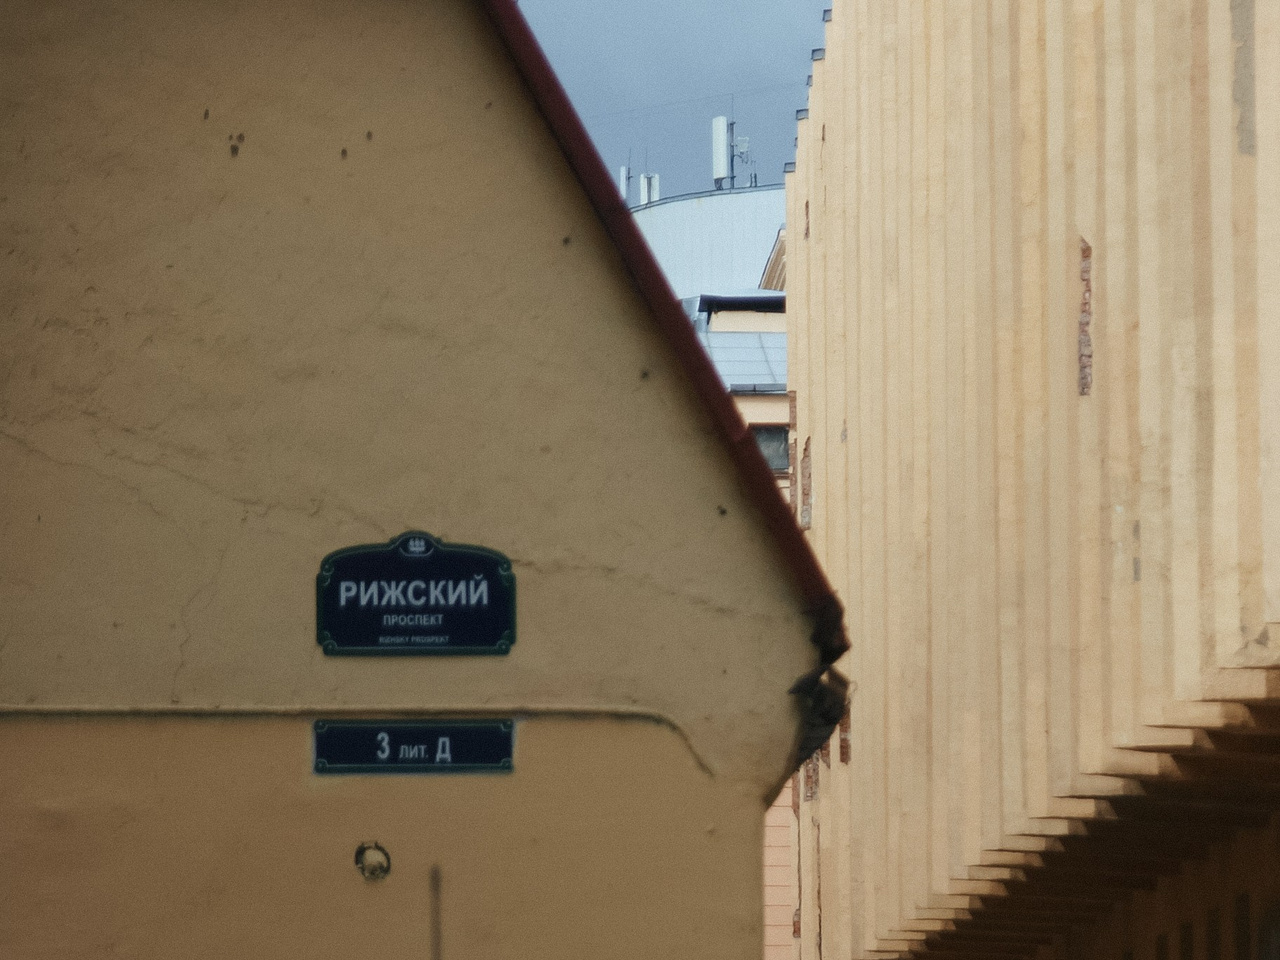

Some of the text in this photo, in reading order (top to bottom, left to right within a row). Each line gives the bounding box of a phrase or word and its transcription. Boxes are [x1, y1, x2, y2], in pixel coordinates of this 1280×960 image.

[339, 573, 489, 607] РИЖСКИЙ
[383, 614, 444, 626] ПРОСПЕКТ
[376, 731, 390, 759] 3
[435, 736, 452, 762] Д
